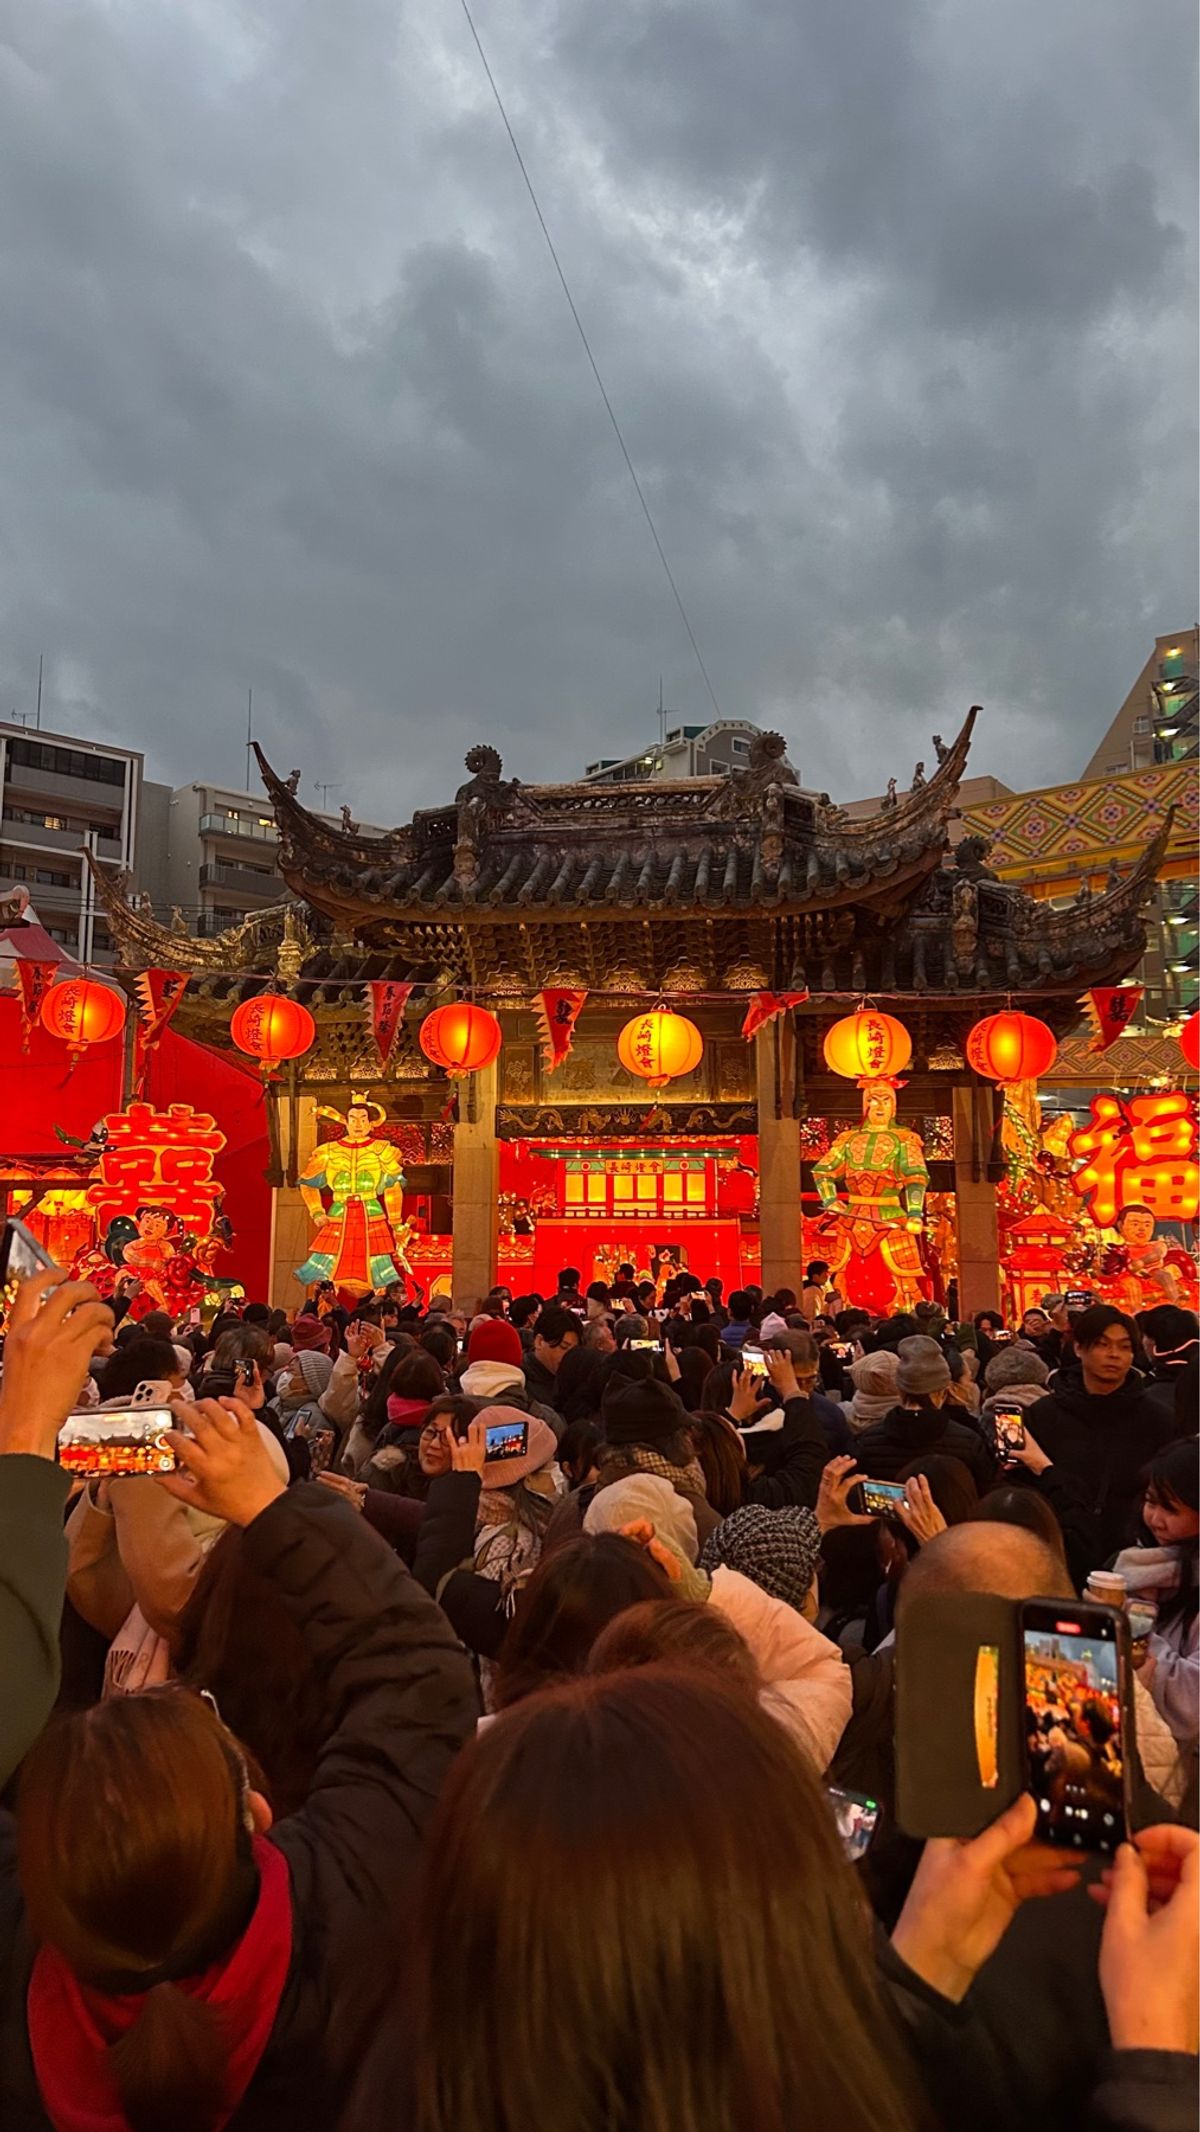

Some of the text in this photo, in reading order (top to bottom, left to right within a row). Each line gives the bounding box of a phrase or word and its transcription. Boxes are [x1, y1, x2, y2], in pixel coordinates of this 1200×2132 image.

[635, 1018, 655, 1069] 長崎燈會
[865, 1018, 886, 1070] 長崎燈會
[607, 1161, 661, 1173] 長崎燈會
[1068, 1091, 1198, 1228] 福
